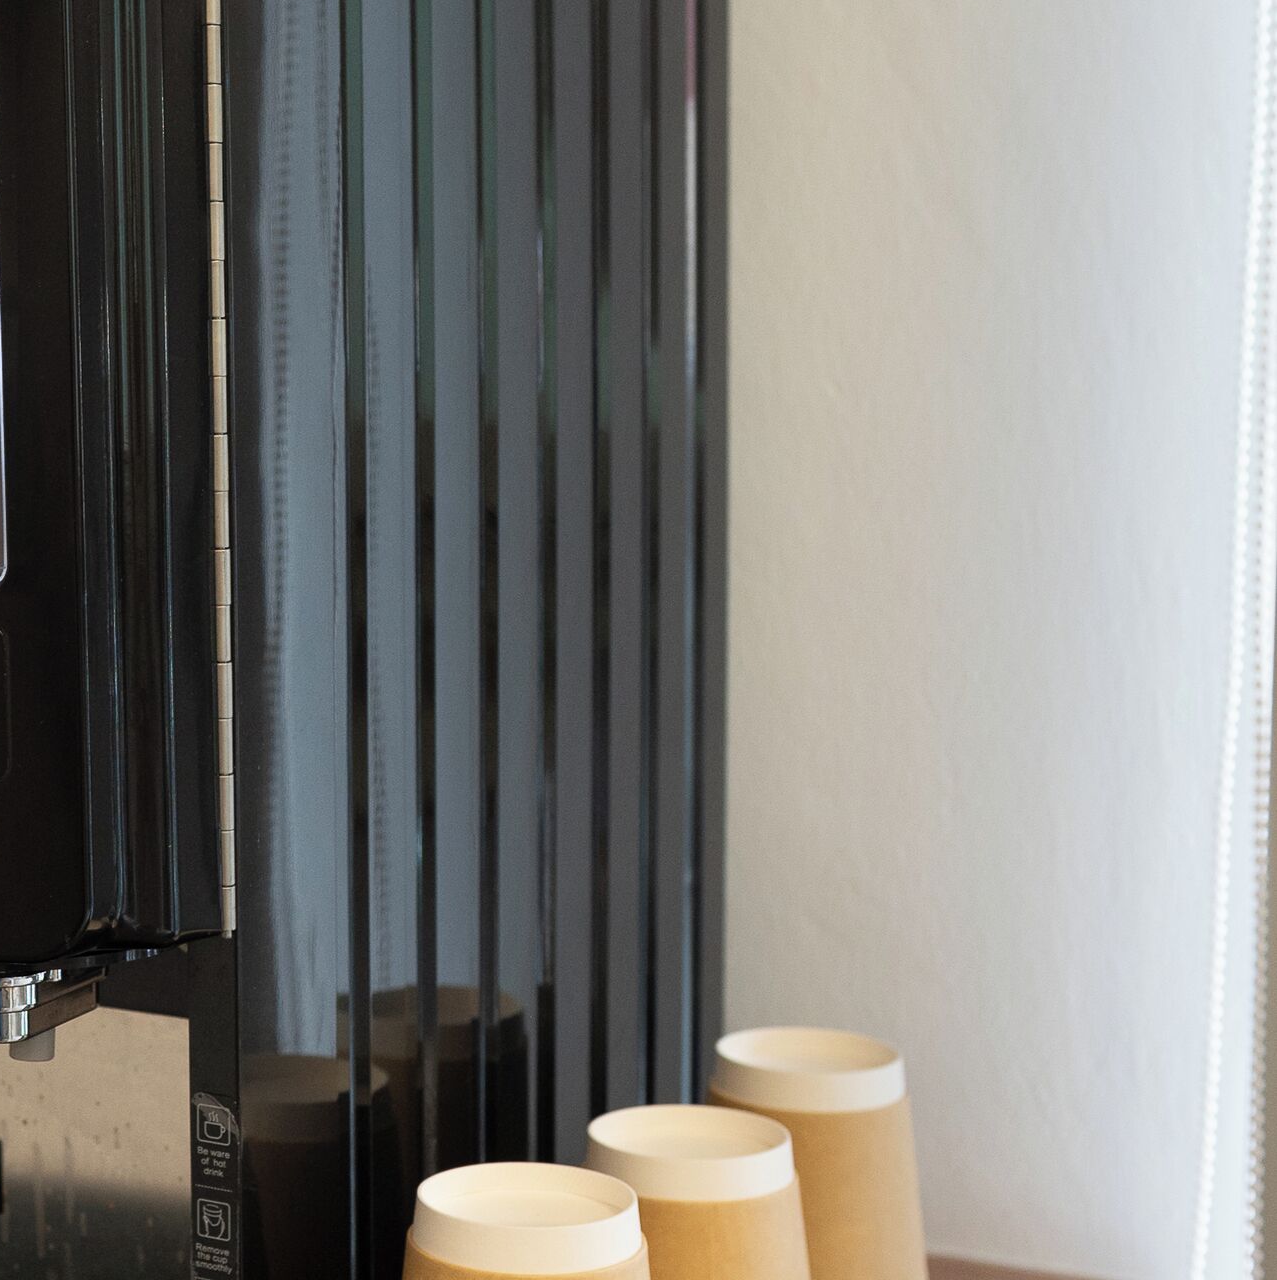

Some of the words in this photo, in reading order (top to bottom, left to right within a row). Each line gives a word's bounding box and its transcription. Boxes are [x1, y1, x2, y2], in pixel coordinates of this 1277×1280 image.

[197, 1146, 209, 1155] Be
[210, 1150, 231, 1159] ware
[201, 1157, 210, 1165] of
[213, 1159, 226, 1168] hot
[203, 1168, 224, 1178] drink
[195, 1242, 230, 1257] Remove
[197, 1251, 211, 1261] the
[212, 1255, 228, 1265] cup
[195, 1260, 233, 1275] smoothly
